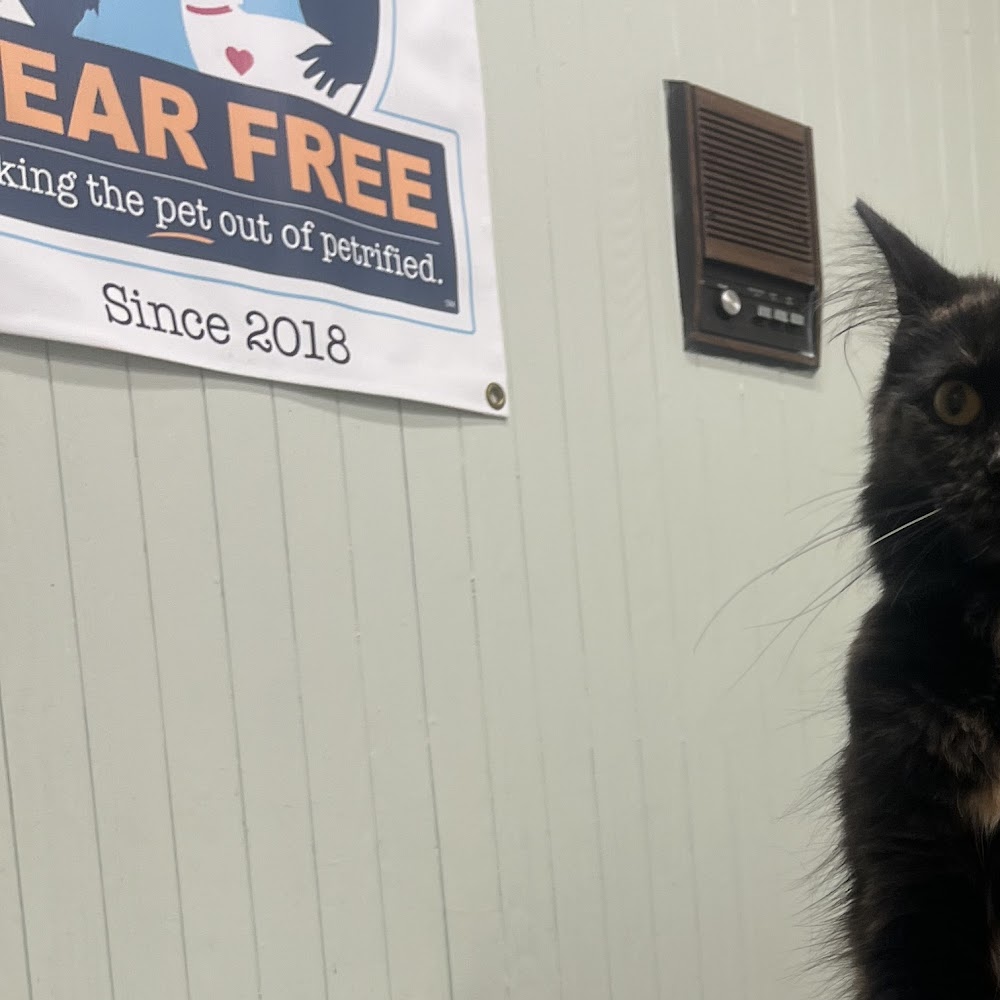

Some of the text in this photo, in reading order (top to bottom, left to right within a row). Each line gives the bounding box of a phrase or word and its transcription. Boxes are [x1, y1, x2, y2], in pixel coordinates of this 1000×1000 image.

[0, 39, 438, 229] EAR FREE
[86, 173, 145, 217] the
[153, 195, 212, 231] pet
[219, 210, 273, 245] out
[281, 220, 316, 252] of
[320, 231, 443, 285] petrified.
[102, 282, 351, 365] Since 2018
